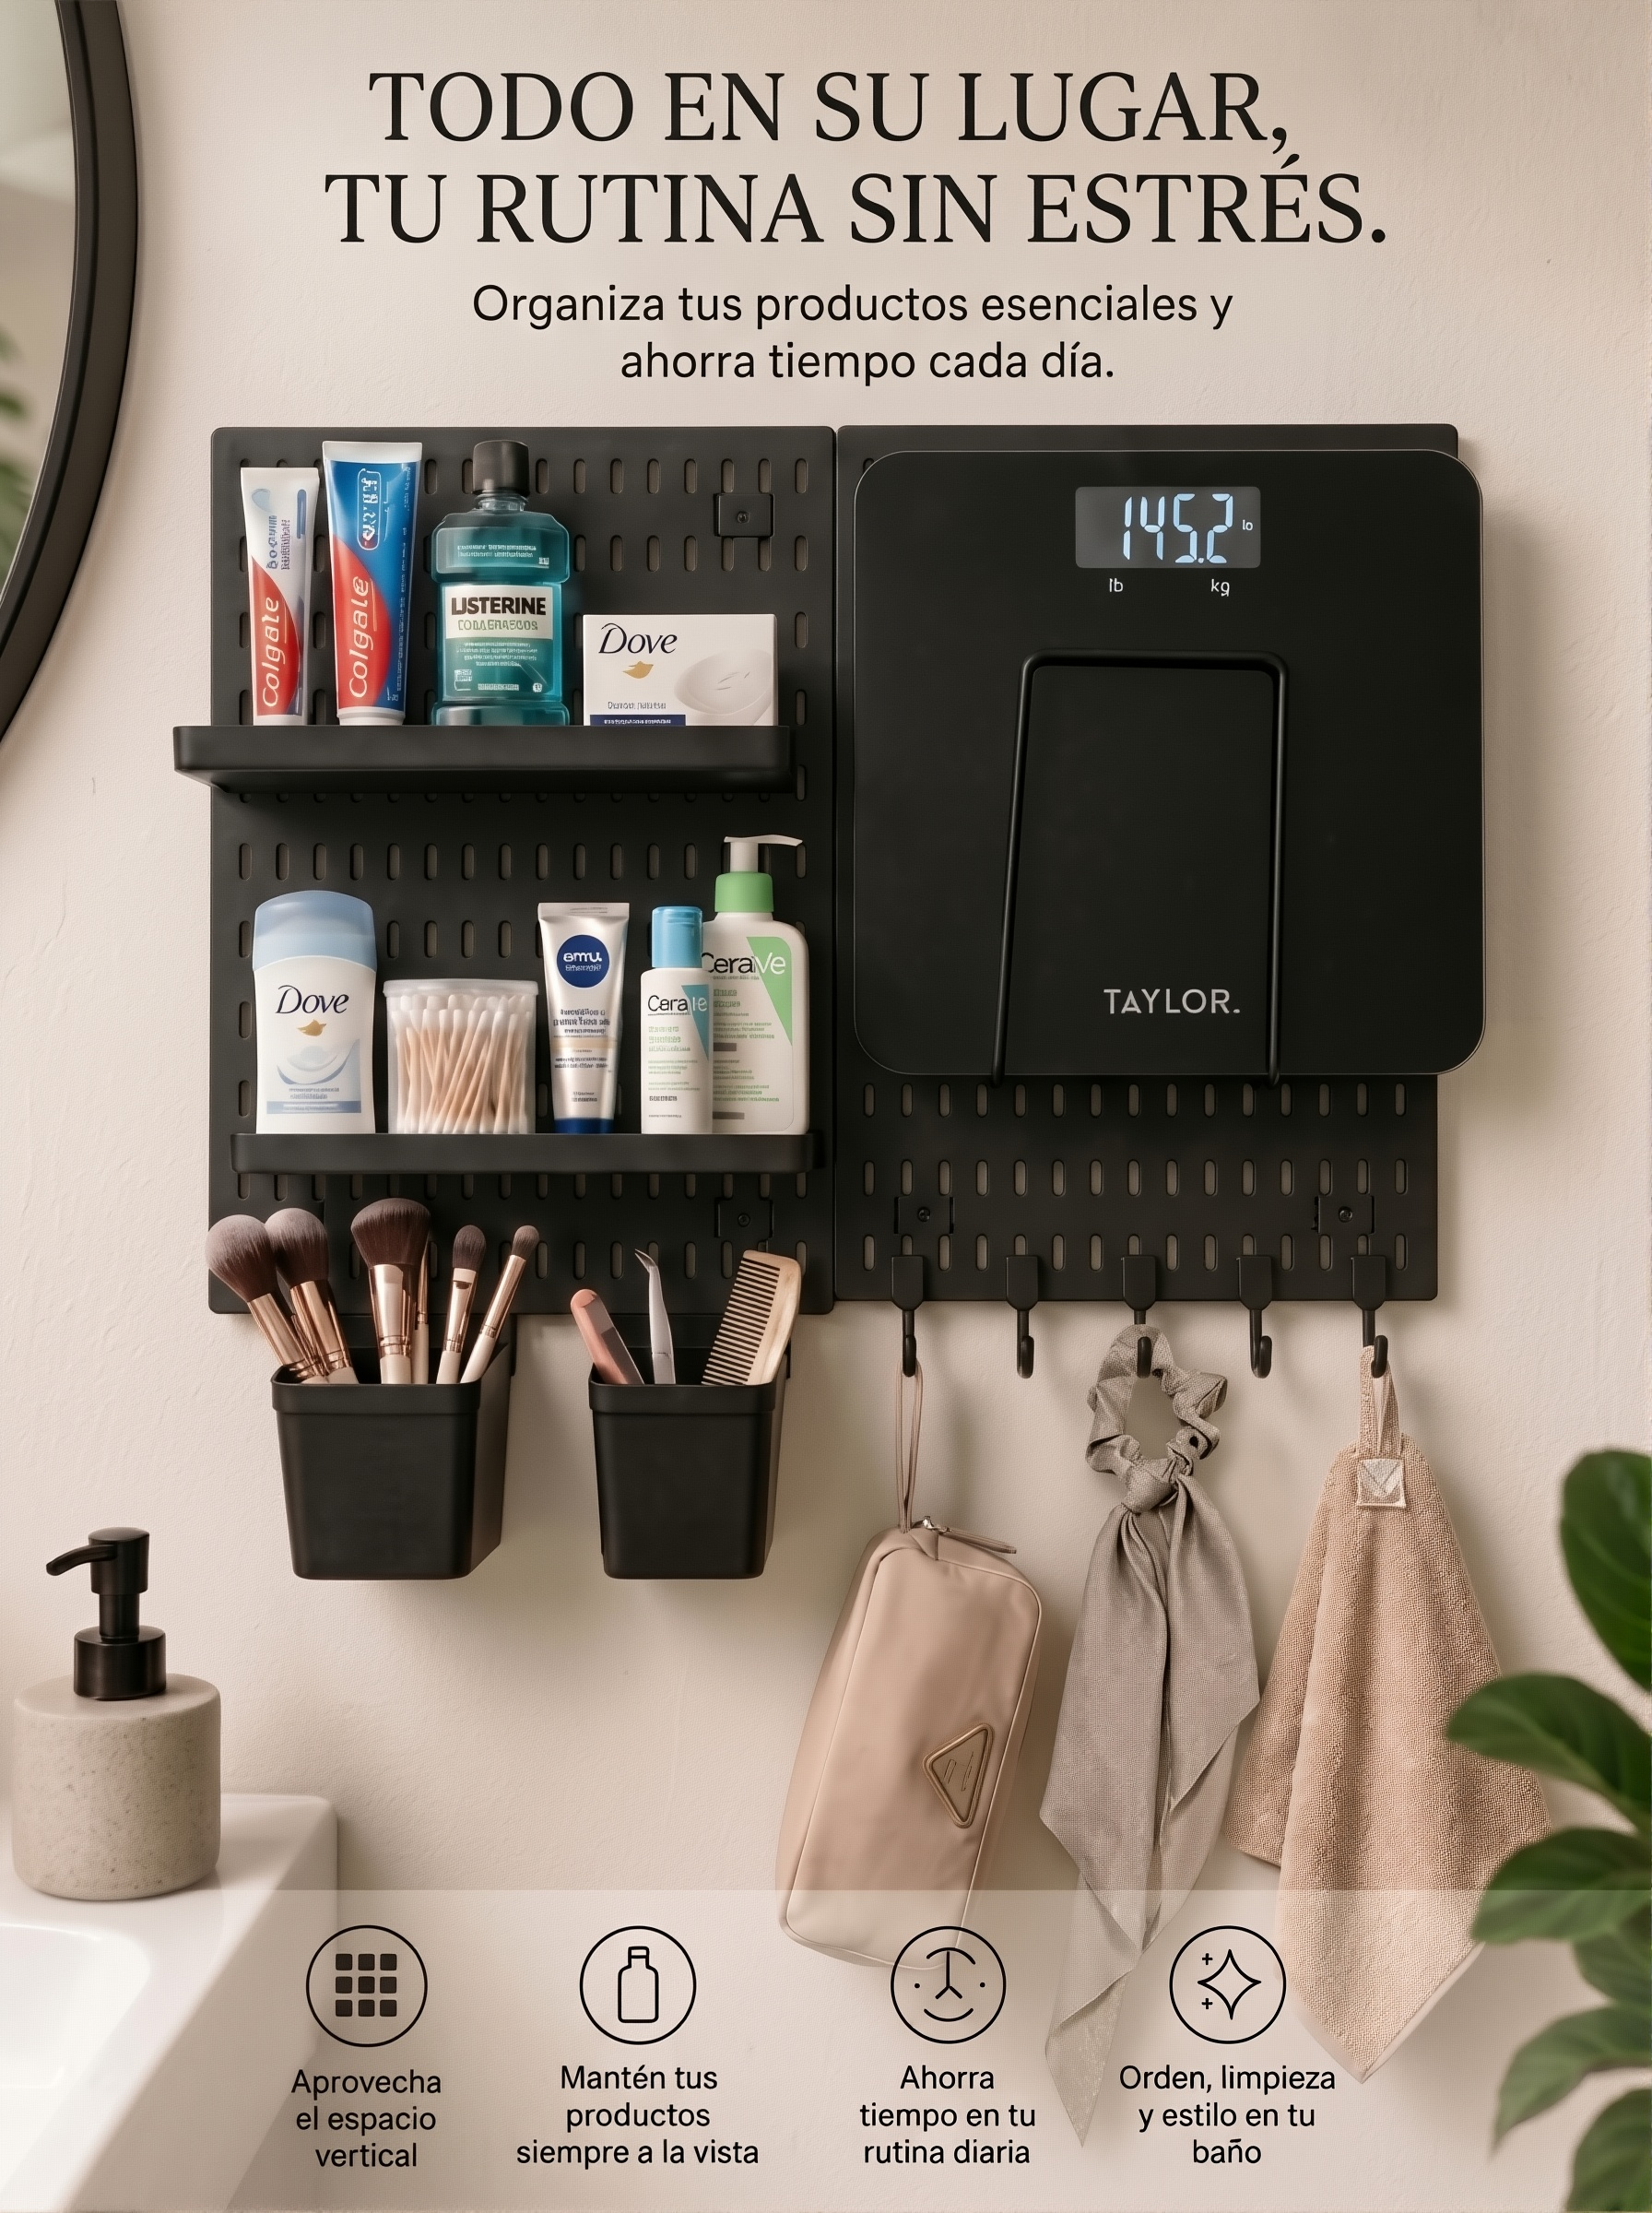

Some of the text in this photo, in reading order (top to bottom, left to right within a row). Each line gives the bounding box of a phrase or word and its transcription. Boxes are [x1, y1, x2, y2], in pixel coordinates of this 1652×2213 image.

[1108, 577, 1124, 593] lb
[1210, 578, 1231, 598] kg
[451, 597, 547, 616] LISTERINE
[598, 622, 678, 655] Dove
[275, 984, 349, 1014] Dove
